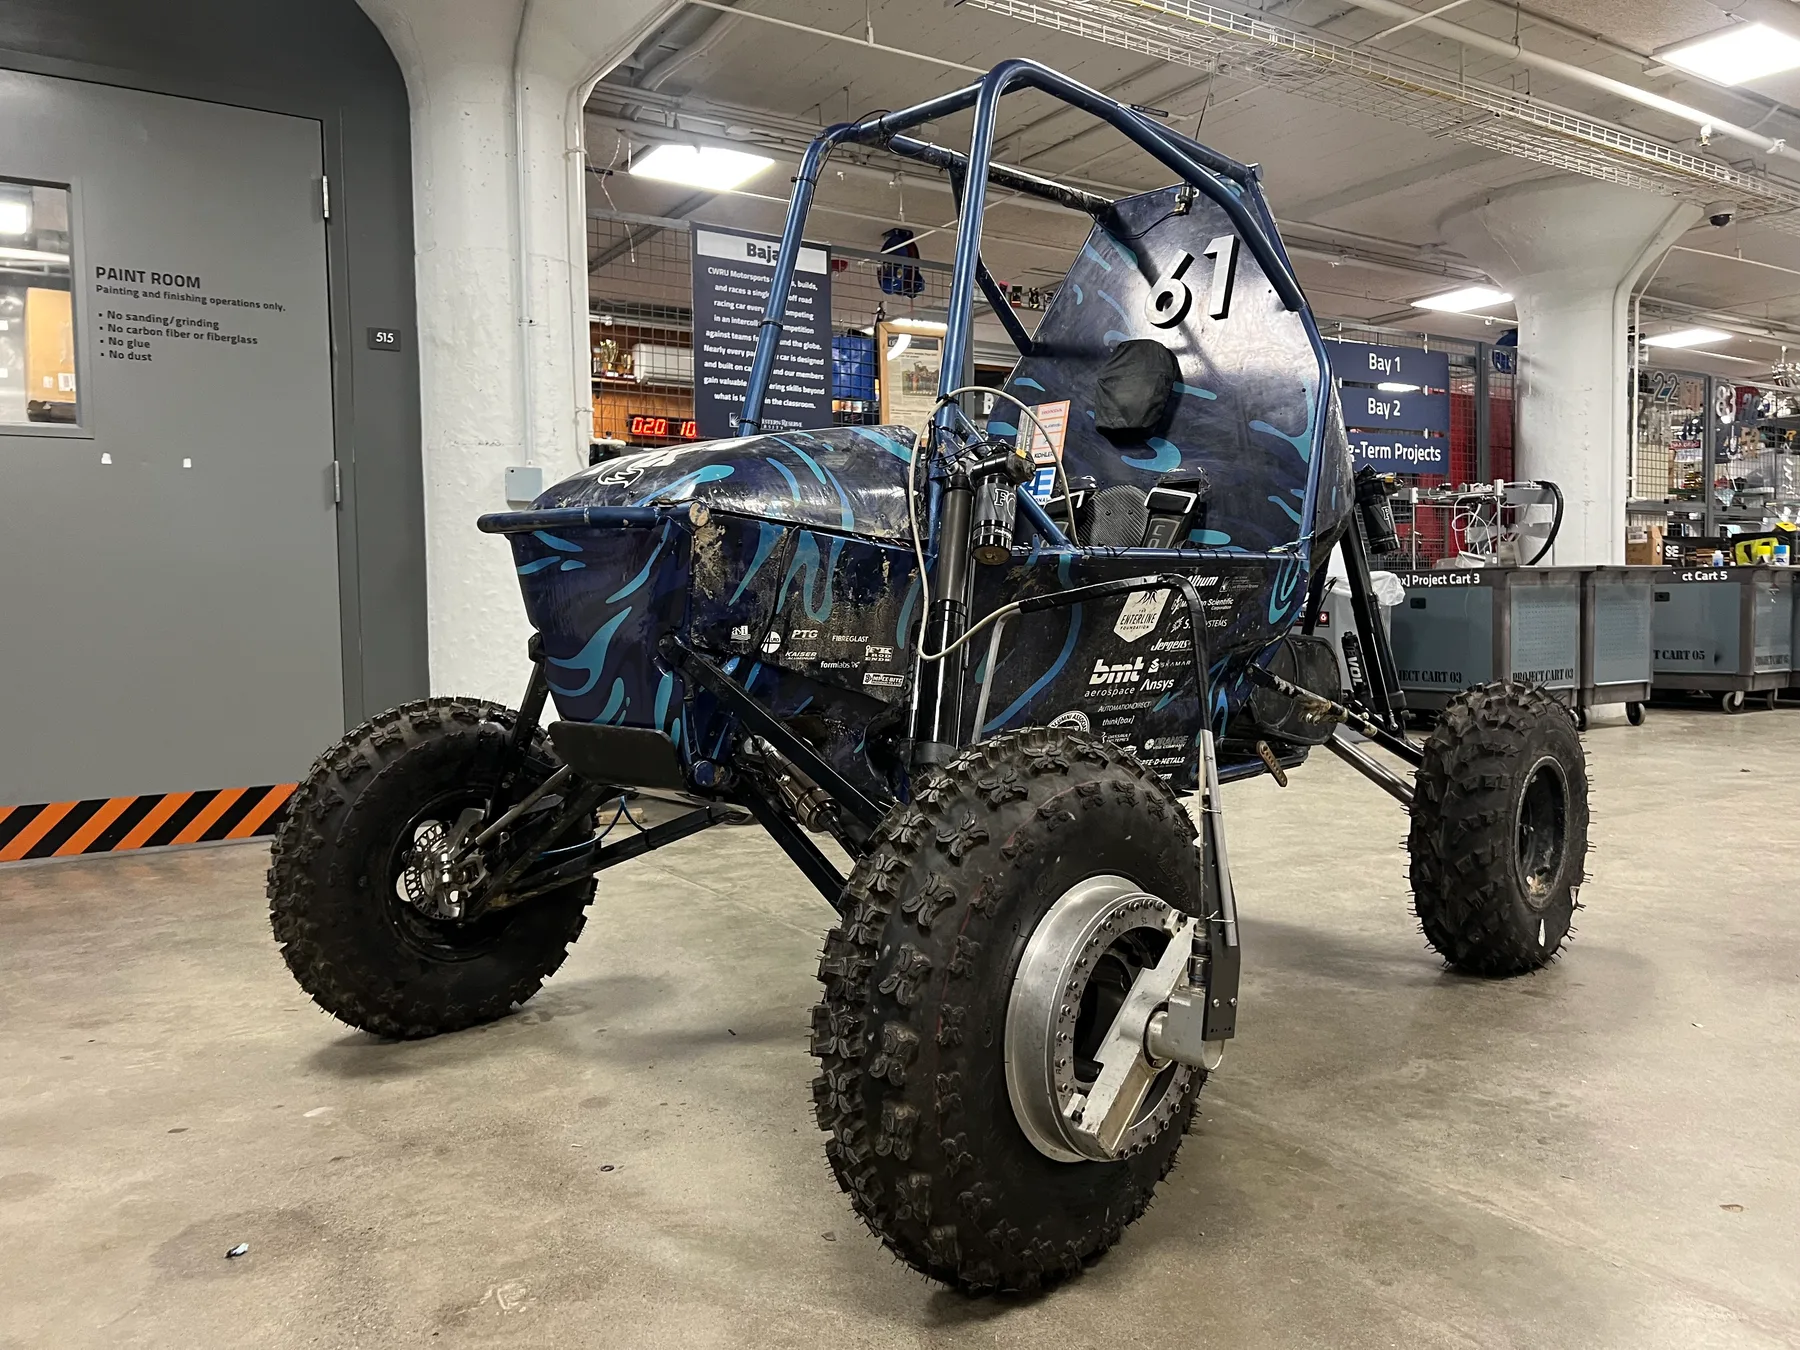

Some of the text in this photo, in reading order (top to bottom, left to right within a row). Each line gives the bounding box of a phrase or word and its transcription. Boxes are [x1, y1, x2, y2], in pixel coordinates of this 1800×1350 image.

[746, 242, 779, 263] Baja
[95, 266, 201, 289] PAINT ROOM
[707, 266, 729, 277] CWRU
[730, 270, 770, 283] Motorsports
[1145, 234, 1240, 329] 61
[96, 284, 286, 312] Painting and finishing operations only.
[714, 284, 728, 292] and
[728, 287, 746, 295] races
[752, 288, 770, 299] singl
[798, 296, 813, 304] road
[713, 300, 815, 321] racing car every ompeting
[107, 310, 220, 331] No sanding/grinding
[713, 314, 721, 322] in
[721, 316, 731, 324] an
[731, 316, 760, 327] intercoll
[107, 323, 258, 345] No carbon fiber or fiberglass
[375, 331, 394, 343] 515
[705, 329, 730, 339] against
[731, 333, 751, 341] teams
[803, 342, 822, 350] globe.
[108, 336, 151, 350] No glue
[108, 349, 153, 362] No dust
[703, 344, 726, 355] Nearly
[726, 348, 745, 357] every
[780, 354, 791, 362] car
[791, 354, 796, 362] is
[797, 355, 824, 366] designed
[1368, 352, 1401, 375] Bay 1
[703, 361, 717, 369] and
[718, 361, 734, 370] built
[796, 371, 824, 380] members
[703, 376, 718, 385] gain
[719, 377, 748, 387] valuable
[786, 384, 802, 393] skills
[803, 386, 825, 395] beyond
[714, 392, 731, 401] what
[764, 397, 771, 405] in
[772, 398, 783, 406] the
[783, 399, 816, 409] classroom.
[1367, 397, 1401, 420] Bay 2
[1347, 441, 1441, 465] g-Term Projects
[1412, 573, 1447, 588] Project
[1449, 573, 1471, 585] Cart
[1473, 573, 1480, 584] 3
[1695, 570, 1718, 581] Cart
[1720, 570, 1728, 581] 5
[1120, 612, 1157, 625] ENTERLINE
[791, 629, 819, 638] PTG
[1662, 650, 1690, 660] CART
[1694, 650, 1705, 660] 05
[820, 660, 851, 669] formlabs
[1089, 656, 1145, 685] bmt
[1399, 669, 1462, 684] JECT CART 03
[1513, 668, 1574, 682] PROJECT CART 03
[1084, 687, 1135, 698] aerospace
[1140, 678, 1175, 691] Ansys
[1102, 714, 1135, 726] think[box]
